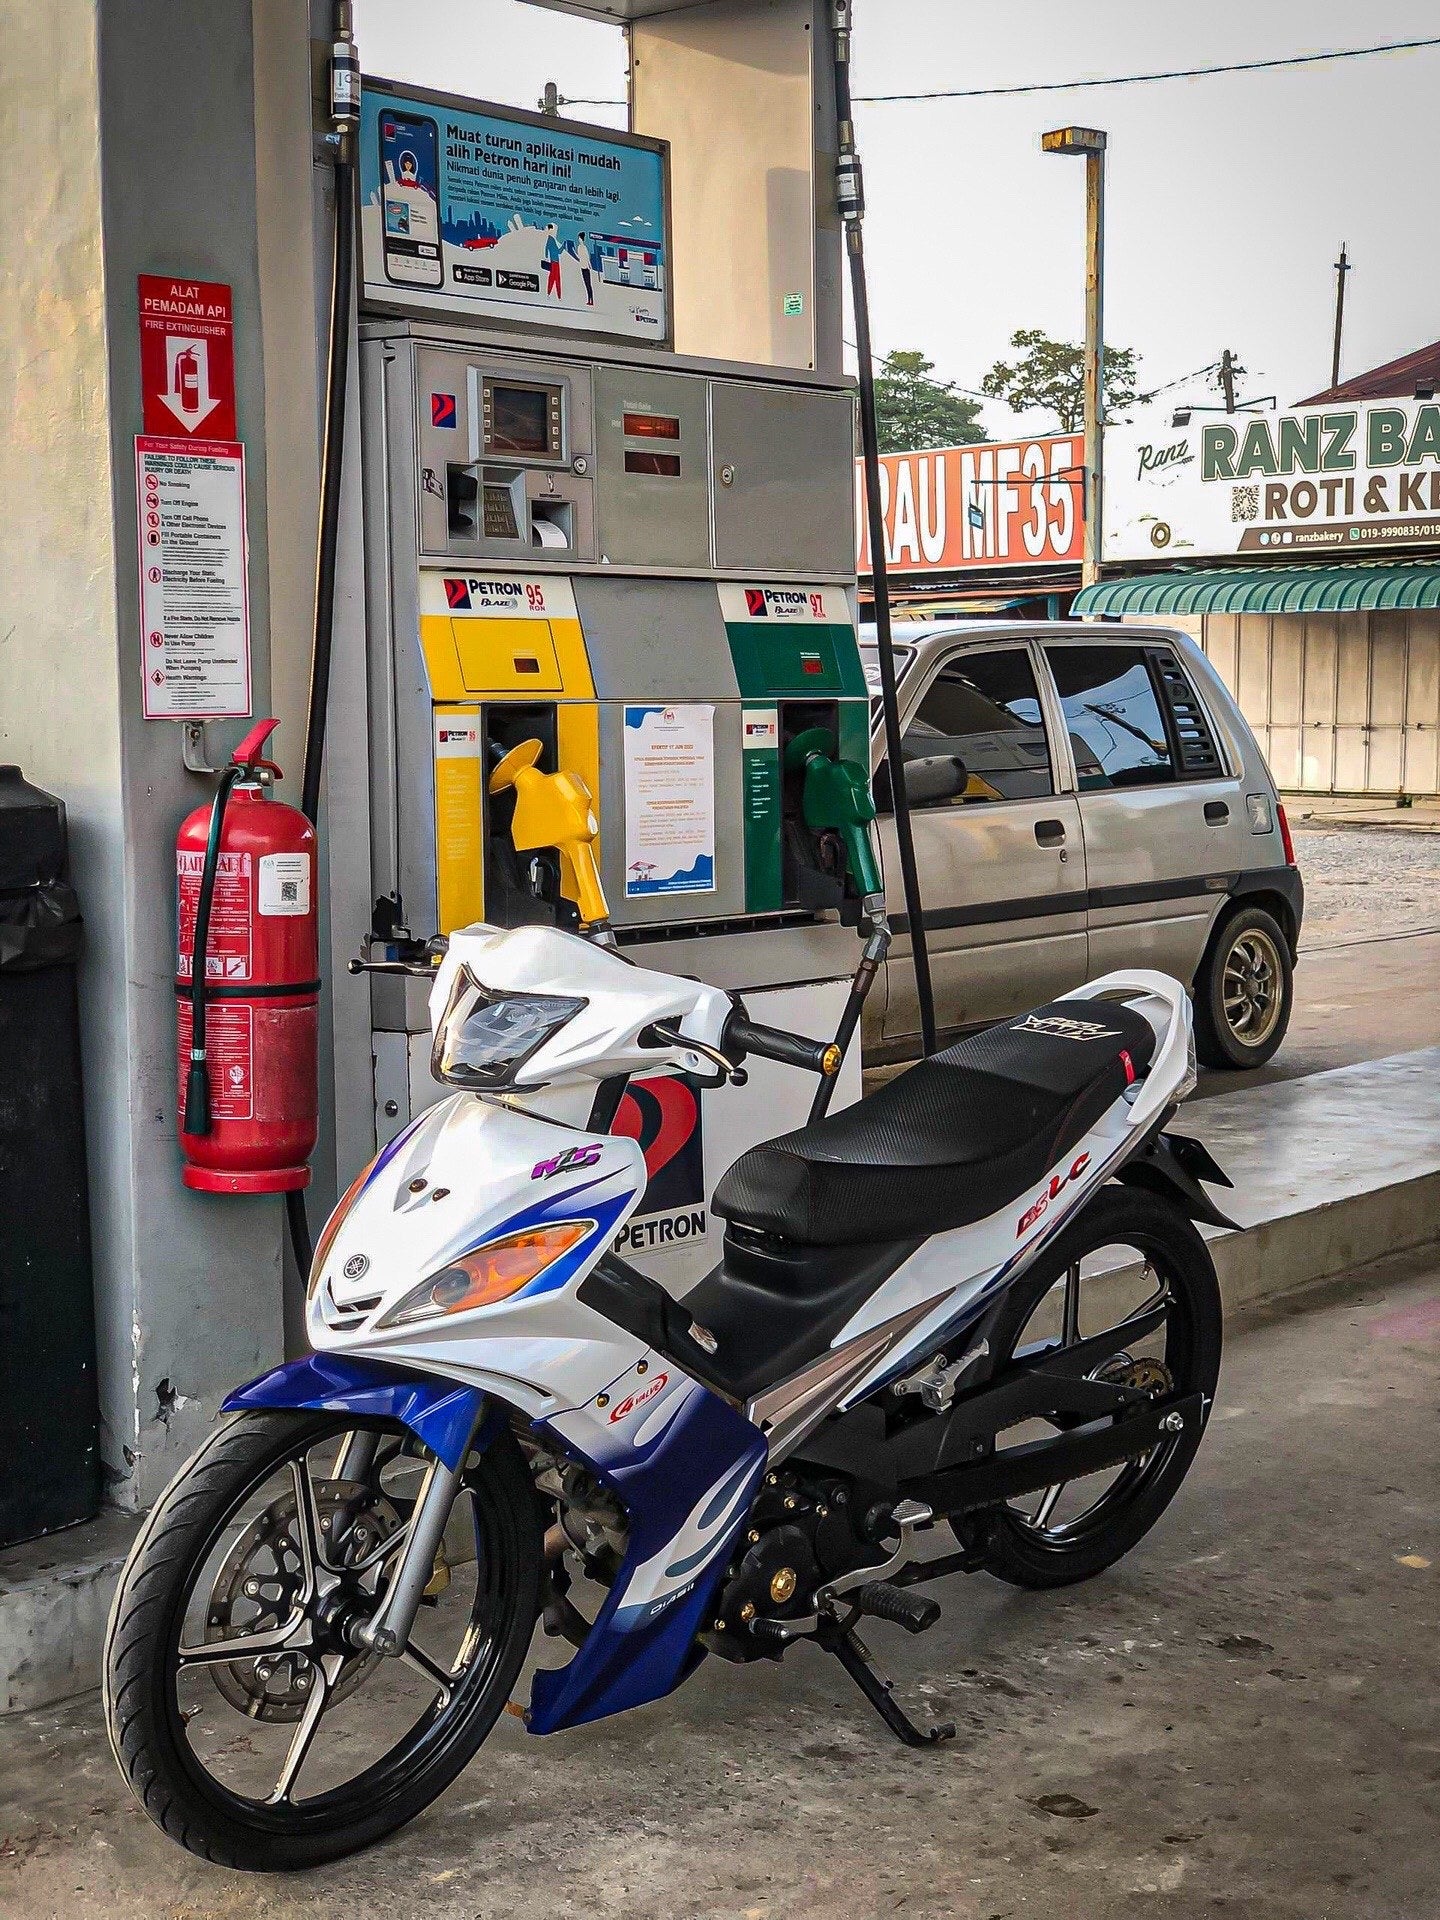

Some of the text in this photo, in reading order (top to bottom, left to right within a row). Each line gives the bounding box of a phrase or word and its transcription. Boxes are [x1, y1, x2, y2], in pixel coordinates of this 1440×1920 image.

[446, 144, 571, 178] alih Petron hari ini!
[447, 124, 621, 170] Muat turun aplikasi mudah
[446, 161, 479, 175] Nikmati
[482, 168, 504, 180] dunia
[506, 174, 531, 185] penuh
[534, 180, 567, 191] ganjaran
[569, 183, 582, 194] dan
[585, 186, 604, 198] lebih
[606, 189, 621, 203] lagi.
[170, 285, 200, 298] ALAT
[464, 274, 475, 282] App
[509, 279, 537, 290] Google Play
[145, 298, 226, 317] PEMADAM API
[146, 320, 226, 336] FIRE EXTINGUISHER
[1138, 439, 1188, 481] Ranz
[1202, 410, 1358, 482] RANZ
[168, 481, 190, 489] Smoking
[1265, 478, 1354, 520] ROTI
[1363, 475, 1390, 513] &
[856, 442, 1074, 566] RAU MF35
[1296, 530, 1343, 543] ranzbakery
[469, 579, 544, 605] PETRON 95
[764, 590, 823, 613] PETRON 97
[614, 1210, 706, 1253] PETRON
[619, 1381, 661, 1414] 4 VALVE
